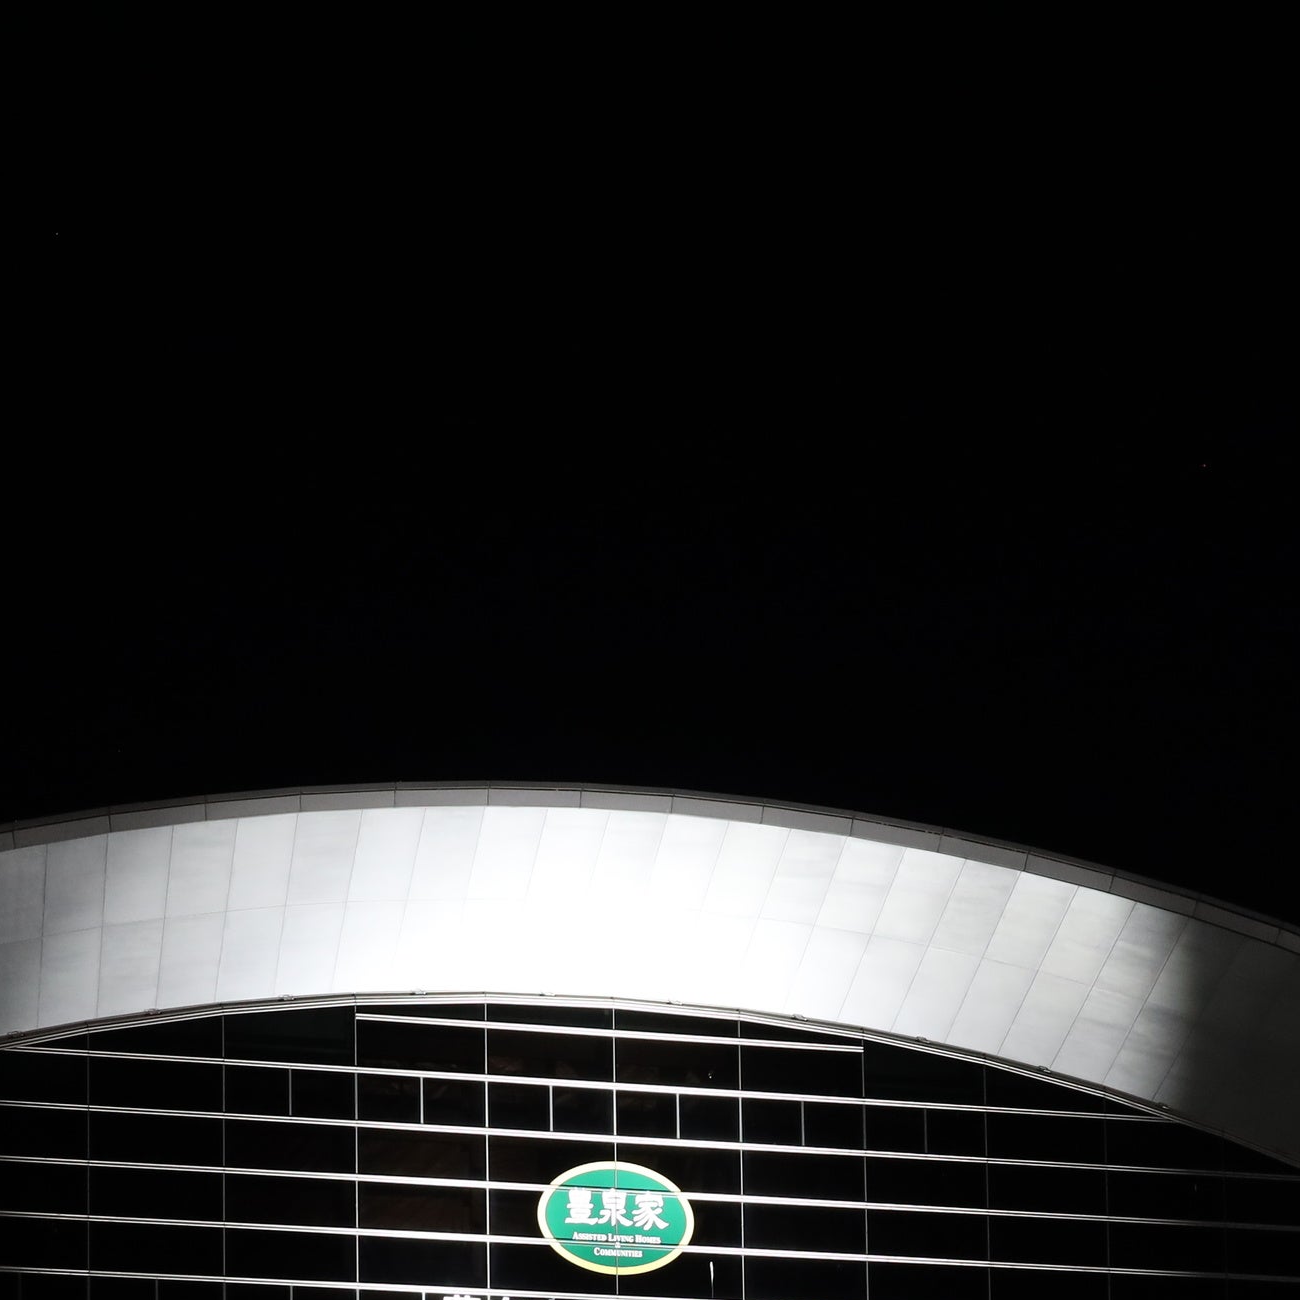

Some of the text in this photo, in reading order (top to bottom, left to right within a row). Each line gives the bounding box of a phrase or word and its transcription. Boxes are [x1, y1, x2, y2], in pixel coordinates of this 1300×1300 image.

[565, 1187, 670, 1231] 豊泉家
[572, 1231, 661, 1245] ASSISTED LIVING HOMES
[593, 1246, 643, 1258] COMMUNITIES
